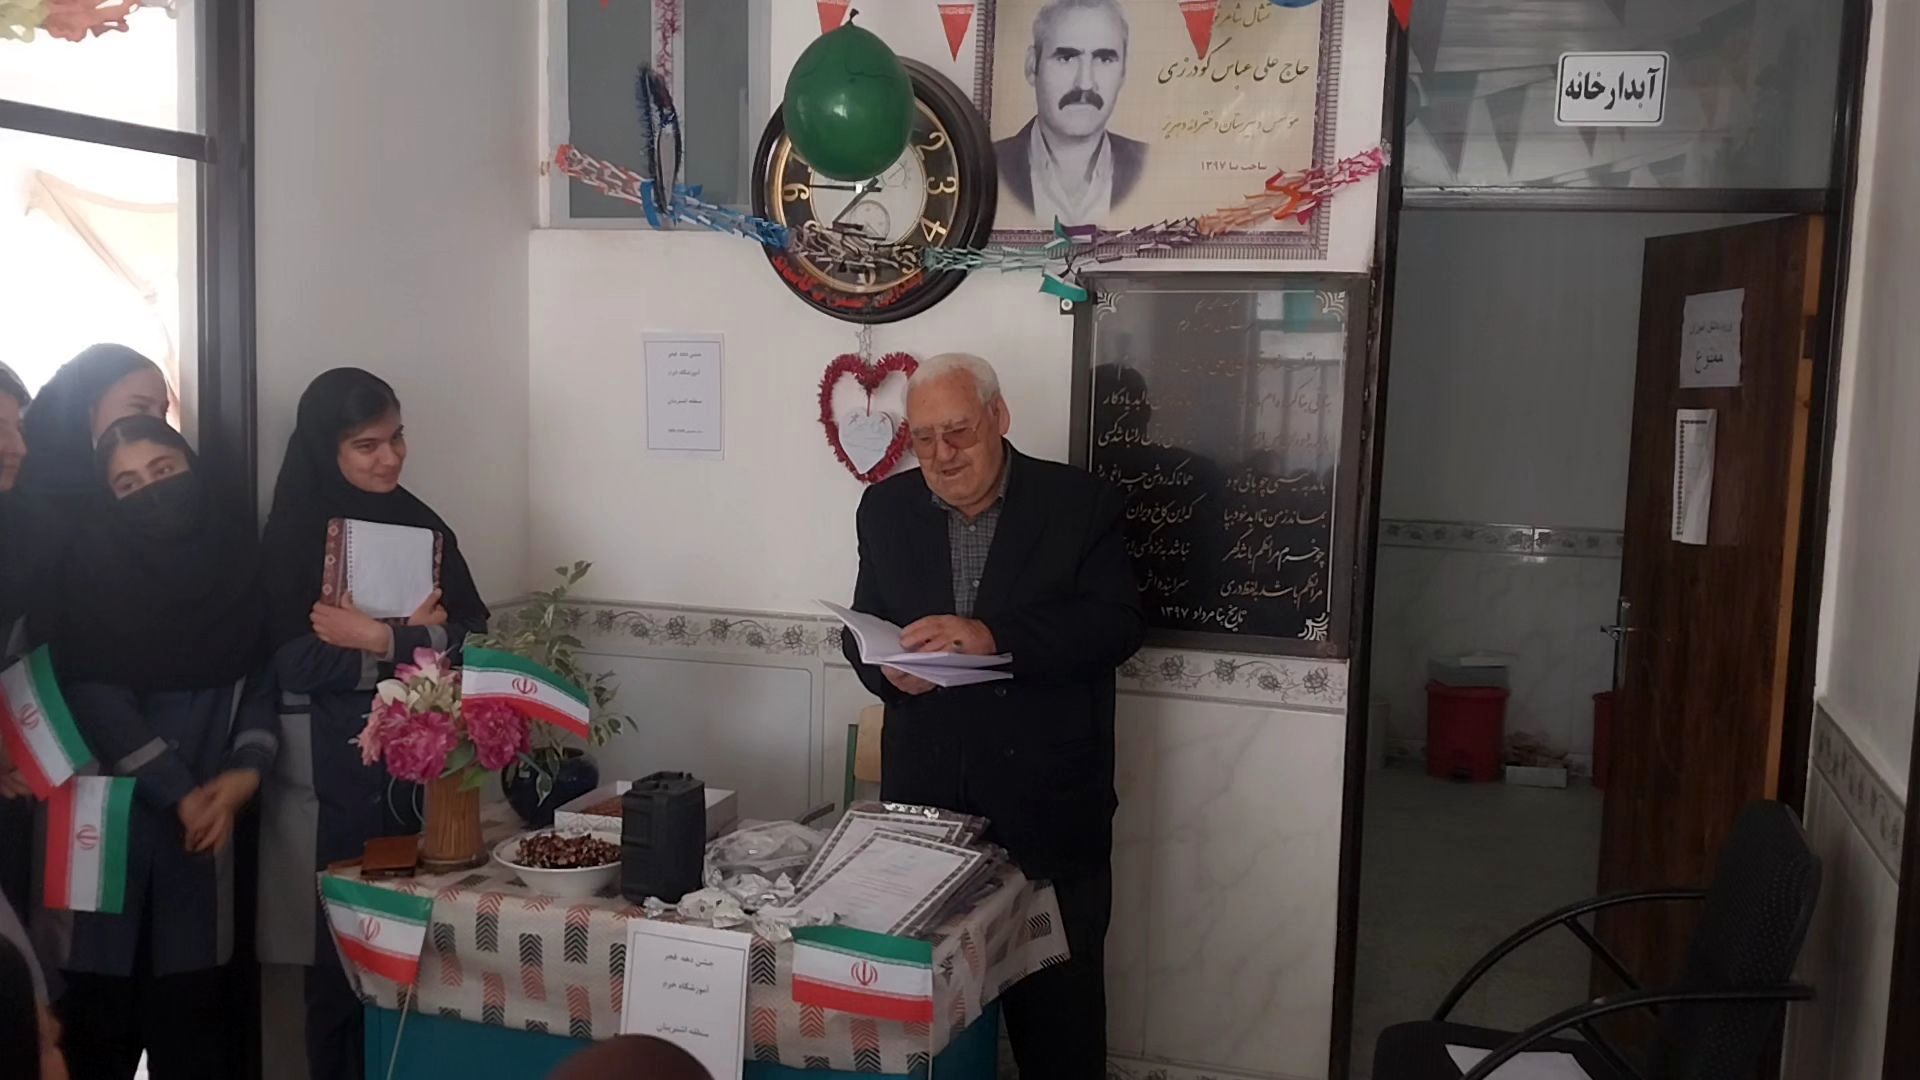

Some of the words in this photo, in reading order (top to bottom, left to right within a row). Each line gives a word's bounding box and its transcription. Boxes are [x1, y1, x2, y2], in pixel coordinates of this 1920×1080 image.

[1211, 60, 1252, 90] عباس
[1253, 56, 1279, 81] علی
[1280, 59, 1310, 83] حاج
[1565, 67, 1661, 110] آبدارخانه
[1200, 160, 1227, 172] ۱۳۹۷
[926, 176, 957, 196] 3
[920, 216, 948, 243] 4
[1160, 605, 1190, 620] ۱۳۹۷
